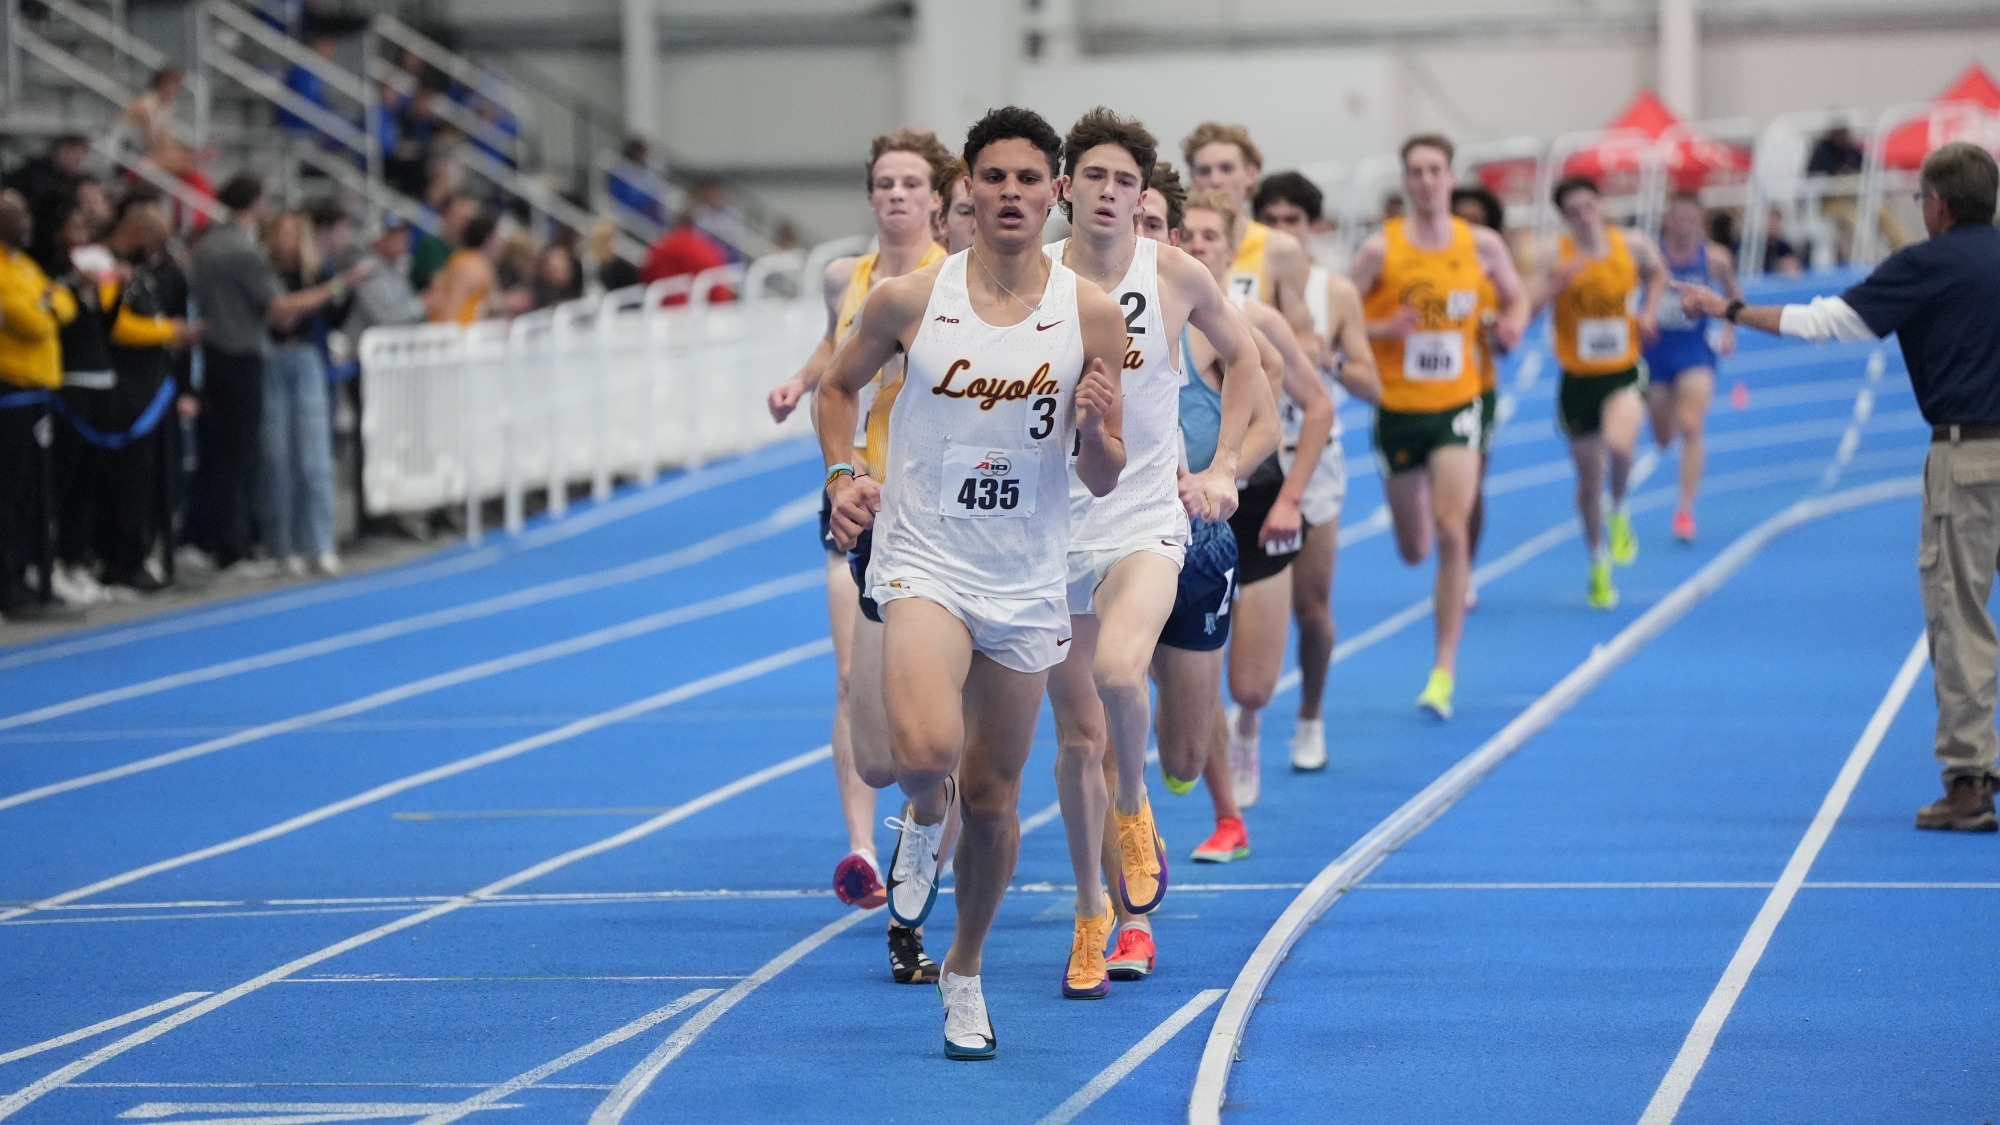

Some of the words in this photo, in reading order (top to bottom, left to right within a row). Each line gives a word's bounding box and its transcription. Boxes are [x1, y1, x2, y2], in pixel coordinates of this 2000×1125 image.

[1119, 291, 1147, 335] 2
[931, 358, 1060, 411] Loyola
[1029, 397, 1057, 440] 3
[957, 478, 1020, 510] 435
